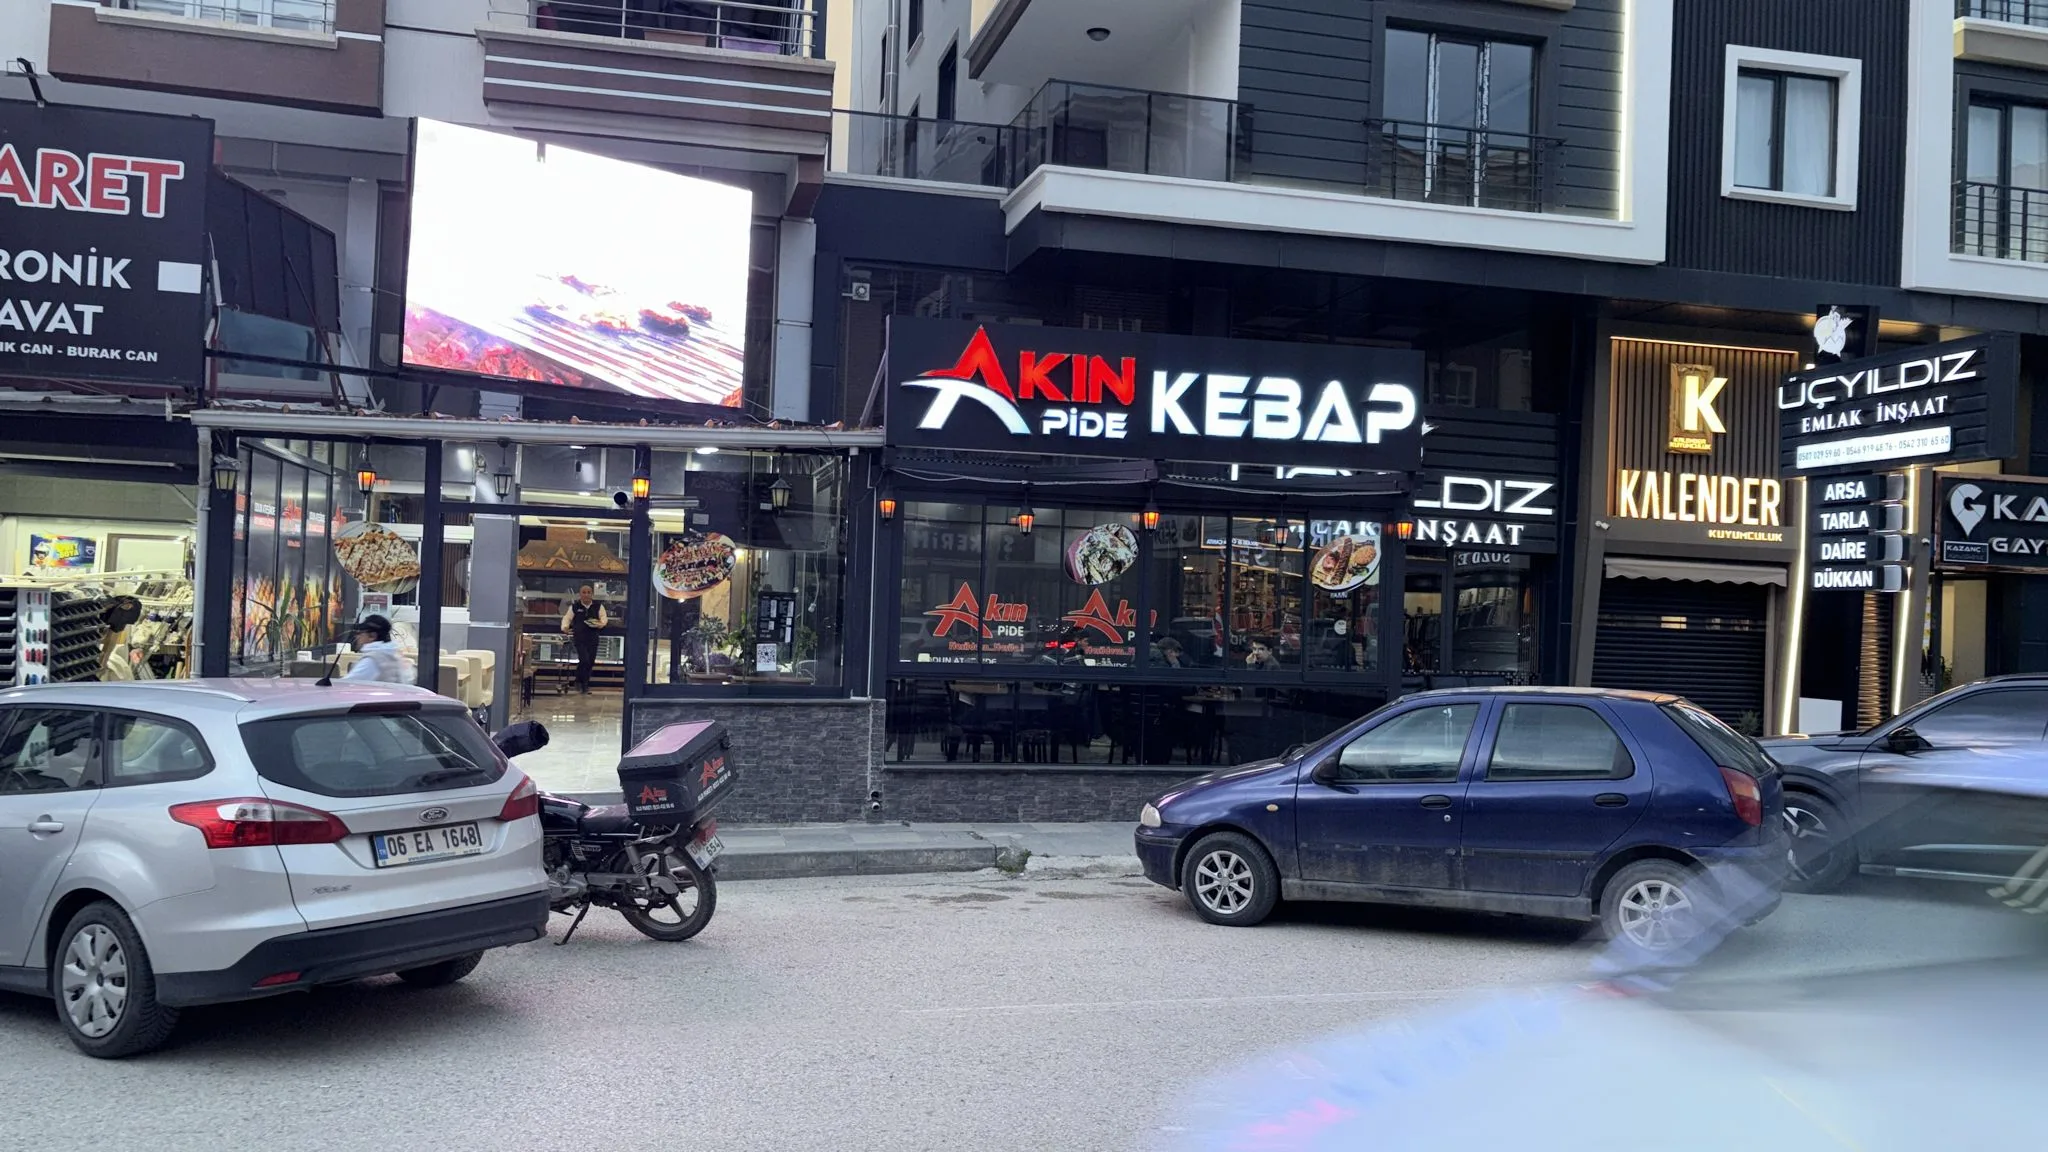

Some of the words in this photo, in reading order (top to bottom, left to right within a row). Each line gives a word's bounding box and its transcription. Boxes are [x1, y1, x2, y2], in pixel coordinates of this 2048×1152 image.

[0, 143, 185, 219] ARET
[0, 298, 104, 336] AVAT
[20, 343, 53, 356] CAN
[67, 346, 121, 361] BURAK
[125, 350, 158, 363] CAN
[901, 324, 1136, 434] AKIN
[1151, 369, 1417, 444] KEBAP
[1778, 349, 1977, 410] ÜÇYILDIZ
[1684, 375, 1730, 433] K
[1801, 411, 1862, 434] EMLAK
[1875, 395, 1949, 424] İNŞAAT
[1618, 469, 1781, 527] KALENDER
[1823, 481, 1866, 500] ARSA
[1708, 529, 1783, 543] KUYUMCULUK
[1820, 510, 1869, 531] TARLA
[1821, 538, 1867, 562] DAİRE
[1813, 568, 1874, 589] DÜKKAN
[426, 808, 444, 819] Ford
[387, 835, 408, 857] 06
[413, 831, 434, 853] EA
[442, 826, 477, 849] 1648
